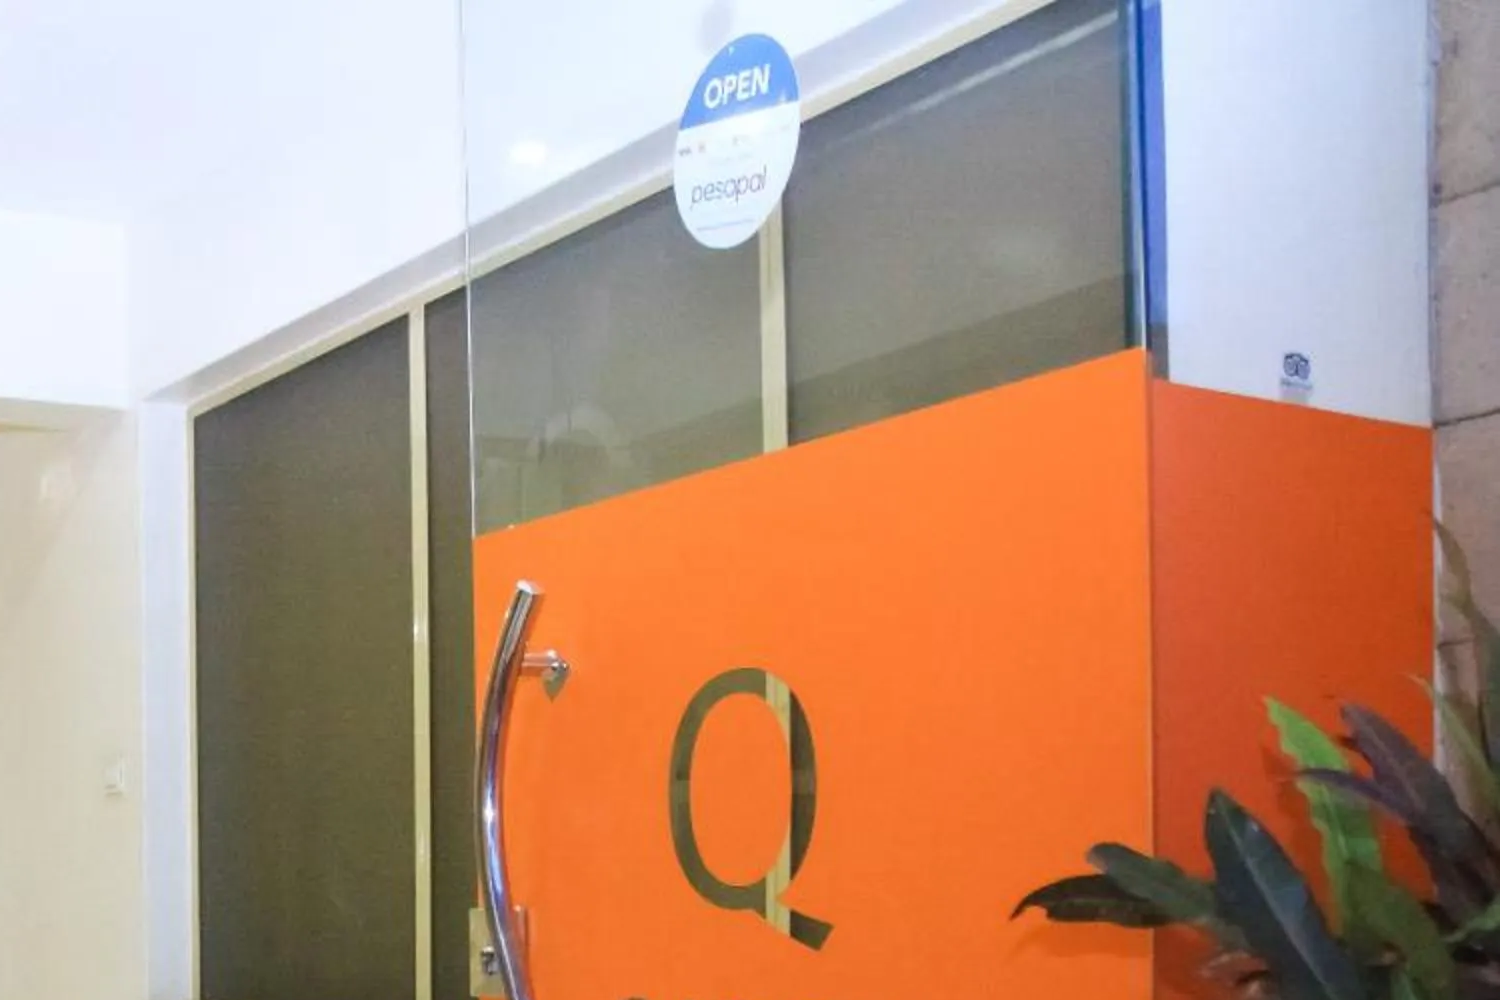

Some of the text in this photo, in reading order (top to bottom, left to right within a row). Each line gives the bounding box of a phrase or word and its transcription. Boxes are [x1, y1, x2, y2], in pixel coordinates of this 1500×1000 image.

[703, 62, 771, 109] OPEN
[690, 164, 768, 212] pesapal
[668, 667, 834, 951] Q
